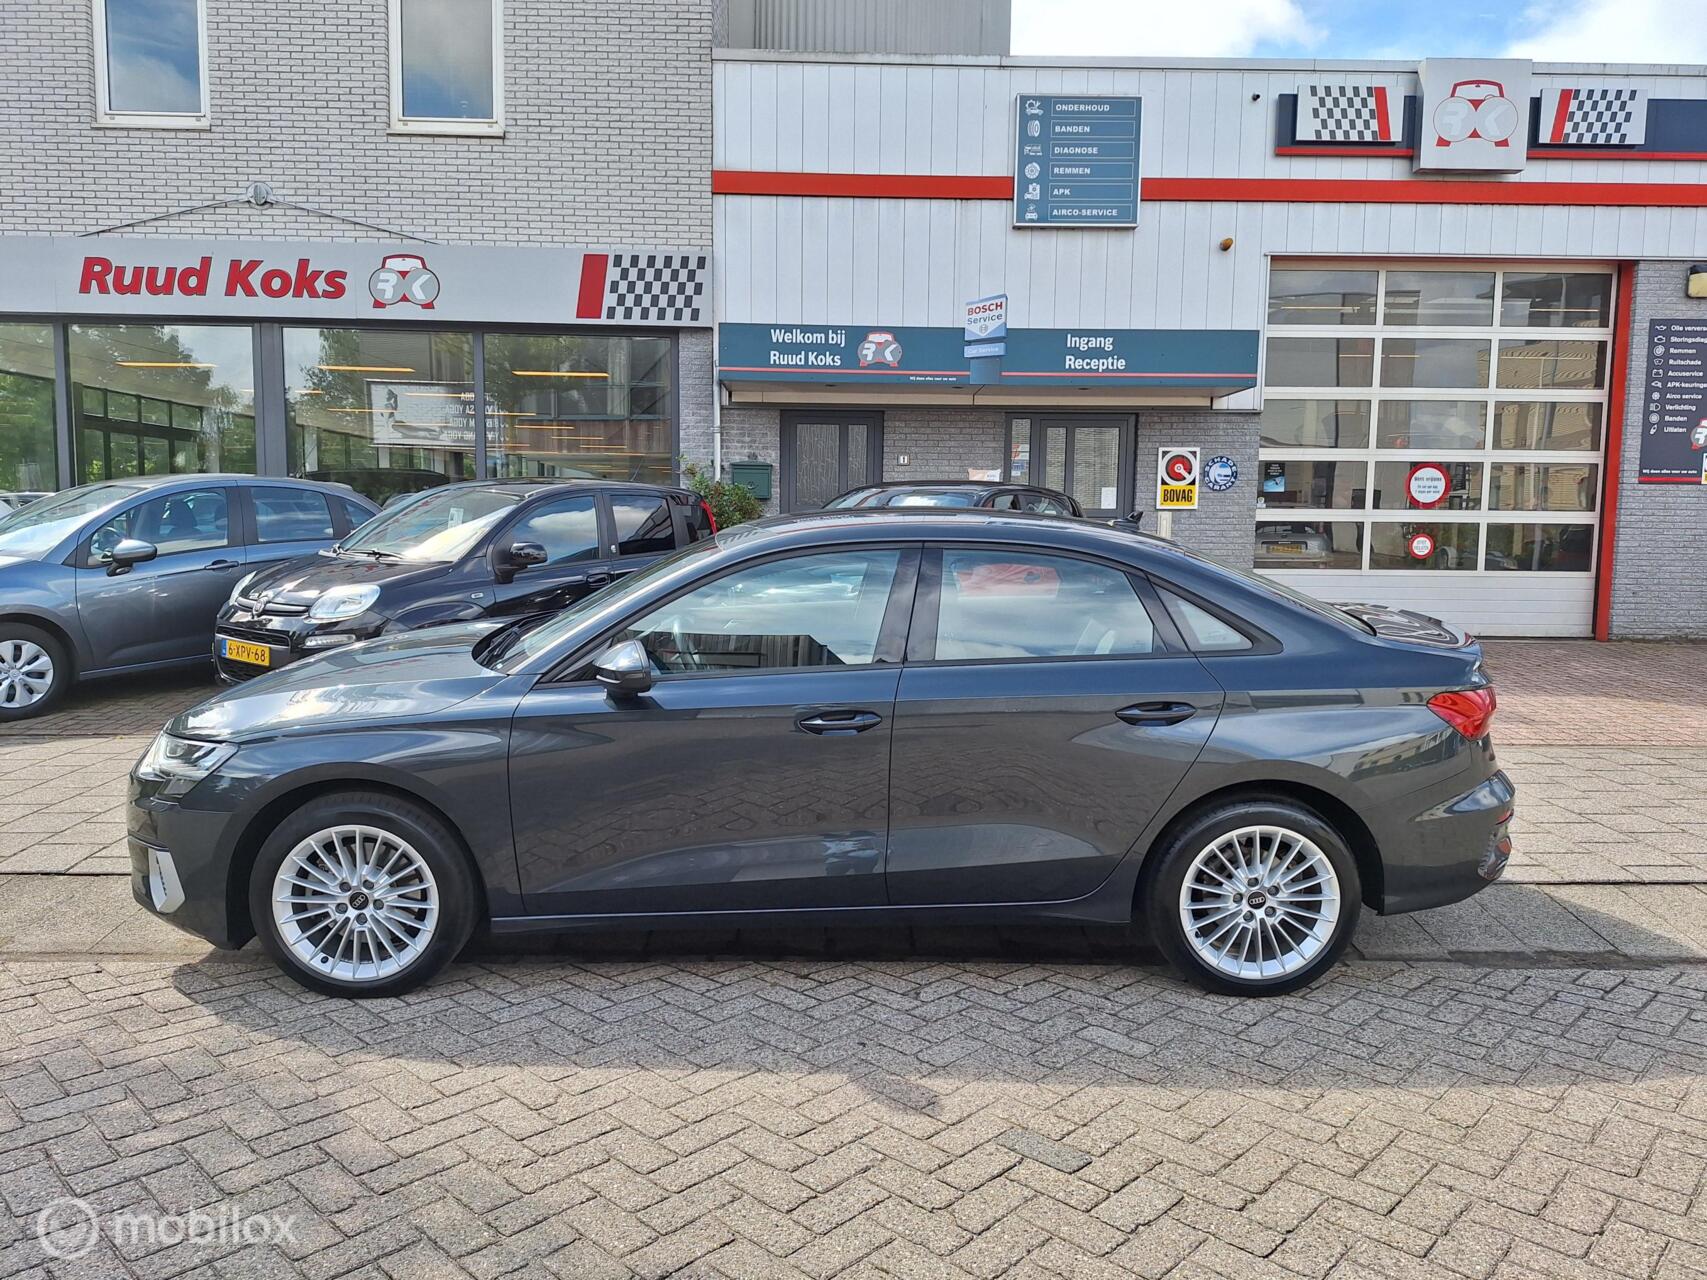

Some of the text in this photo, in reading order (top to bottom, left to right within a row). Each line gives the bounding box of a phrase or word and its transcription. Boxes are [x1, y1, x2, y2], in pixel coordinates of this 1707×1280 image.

[1055, 104, 1110, 112] ONDERHOUD
[1054, 125, 1091, 133] BANDEN
[1054, 146, 1099, 154] DIAGNOSE
[1053, 167, 1091, 175] REMMEN
[1052, 188, 1071, 196] APK
[1052, 208, 1118, 216] AIRCO-SERVICE
[79, 256, 348, 299] Ruud Koks
[967, 301, 1004, 316] BOSCH
[967, 313, 1003, 325] Service
[770, 328, 846, 348] Welkom bij
[1066, 333, 1114, 351] Ingang
[769, 350, 842, 366] Ruud Koks
[1065, 355, 1126, 372] Receptie
[1204, 456, 1237, 472] SCHADE
[1204, 476, 1236, 491] GARANT
[1163, 488, 1193, 503] BOVAG
[228, 643, 266, 662] 6-XPV-68
